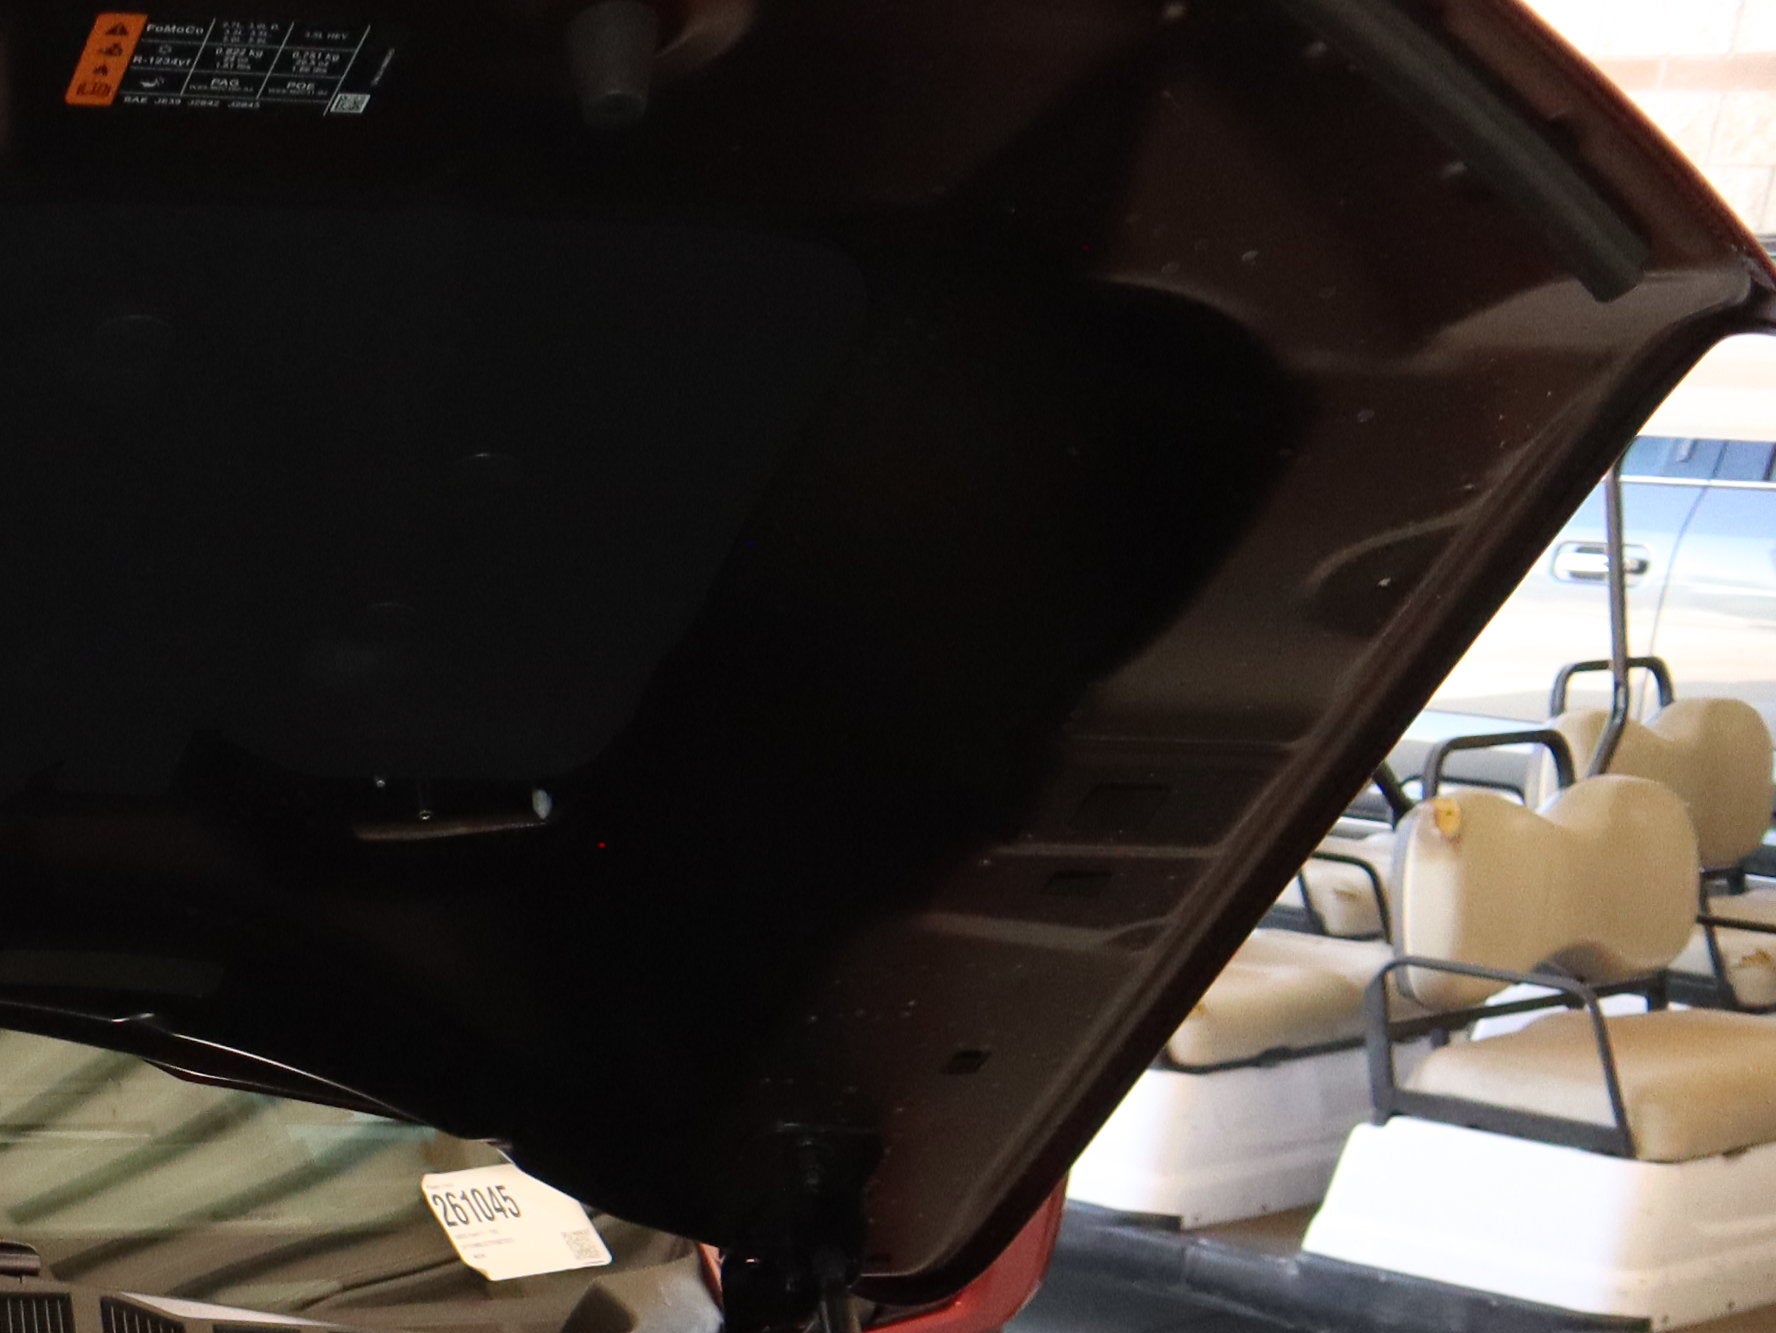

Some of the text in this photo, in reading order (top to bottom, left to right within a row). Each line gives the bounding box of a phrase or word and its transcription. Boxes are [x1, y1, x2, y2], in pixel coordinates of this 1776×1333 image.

[146, 23, 204, 35] FoMoCo
[132, 56, 191, 67] R-1234yf
[210, 78, 240, 87] PAG
[432, 1185, 522, 1228] 261045
